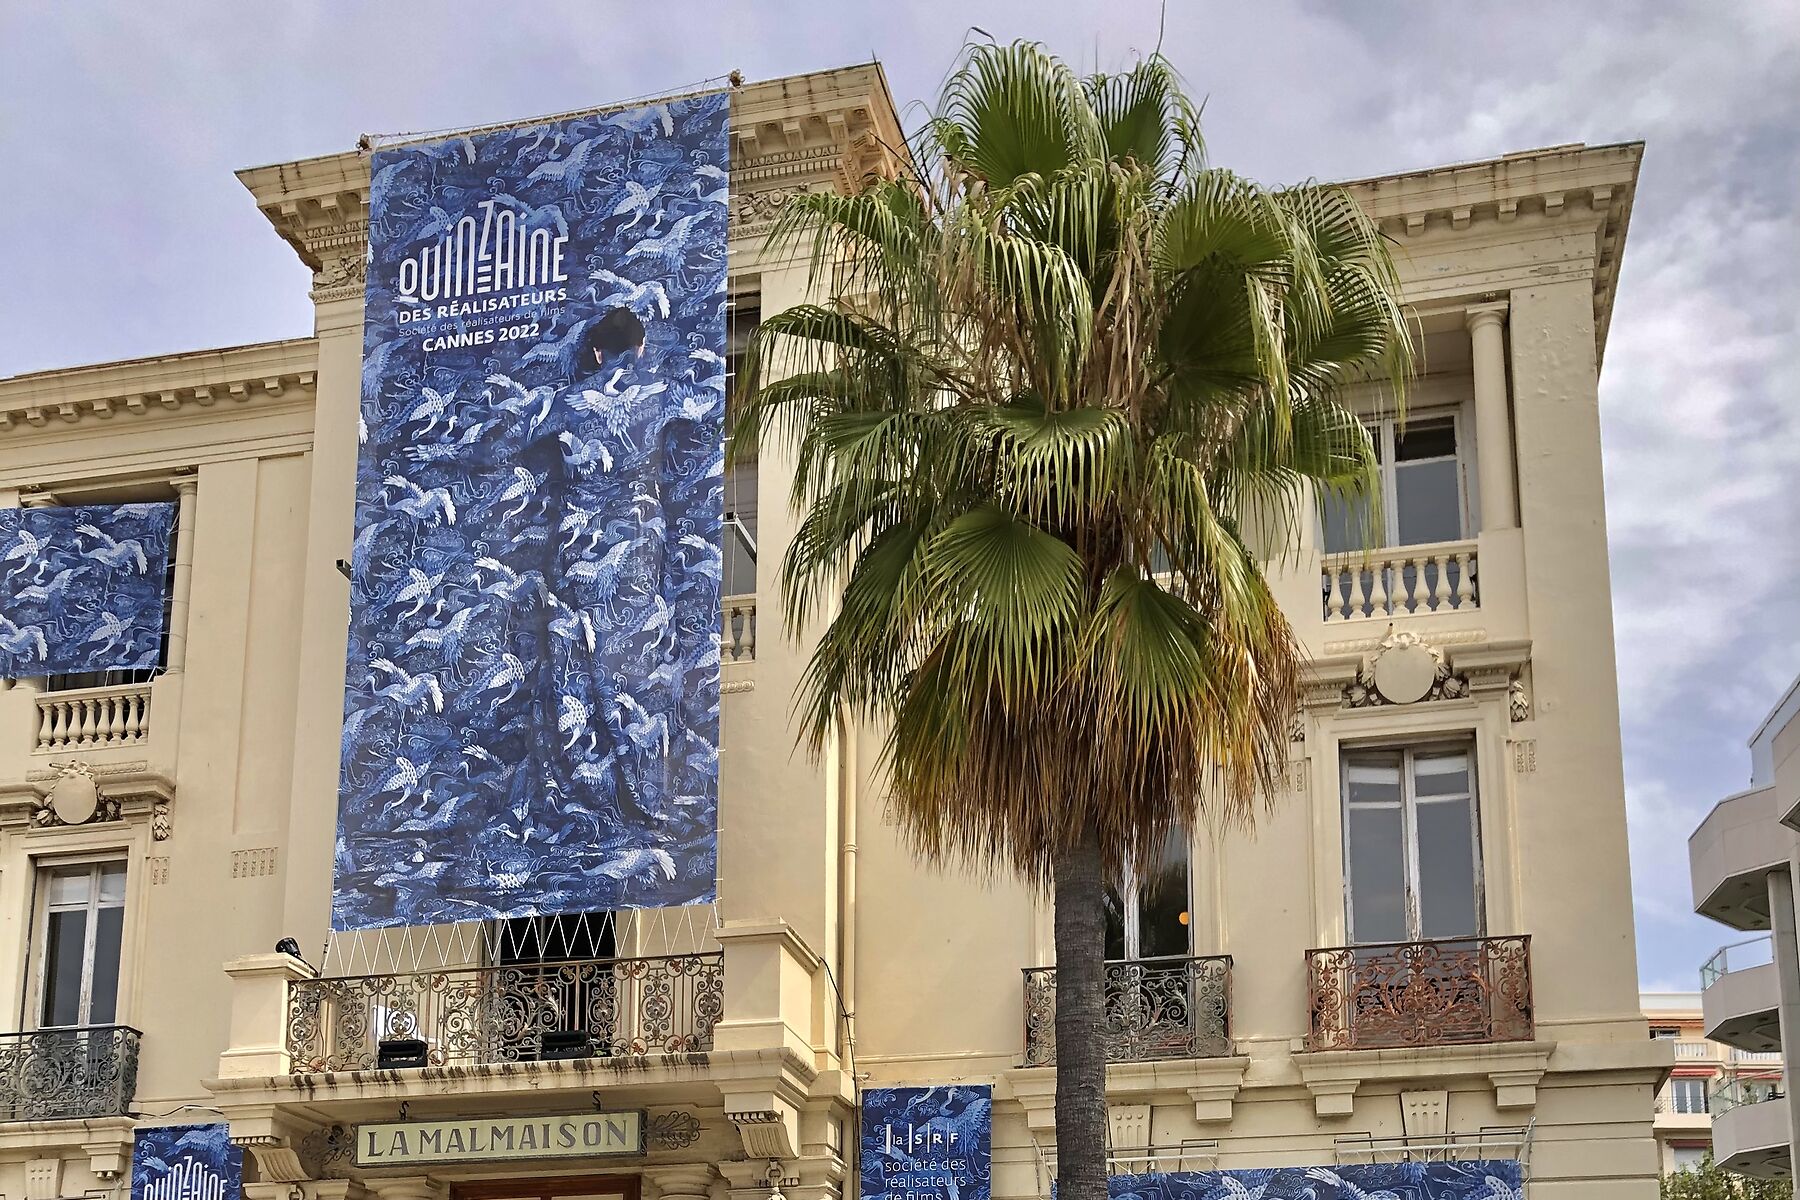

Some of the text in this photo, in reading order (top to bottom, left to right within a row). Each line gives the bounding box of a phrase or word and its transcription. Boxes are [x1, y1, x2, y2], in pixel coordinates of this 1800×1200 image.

[399, 287, 567, 324] DES RÉALISATEURS
[398, 323, 437, 337] Société
[440, 322, 459, 332] des
[461, 313, 521, 328] réalisateurs
[524, 310, 538, 319] de
[422, 323, 540, 352] CANNES 2022
[367, 1119, 627, 1157] LA MALMAISON
[885, 1157, 966, 1172] société des
[885, 1174, 967, 1188] réalisateurs
